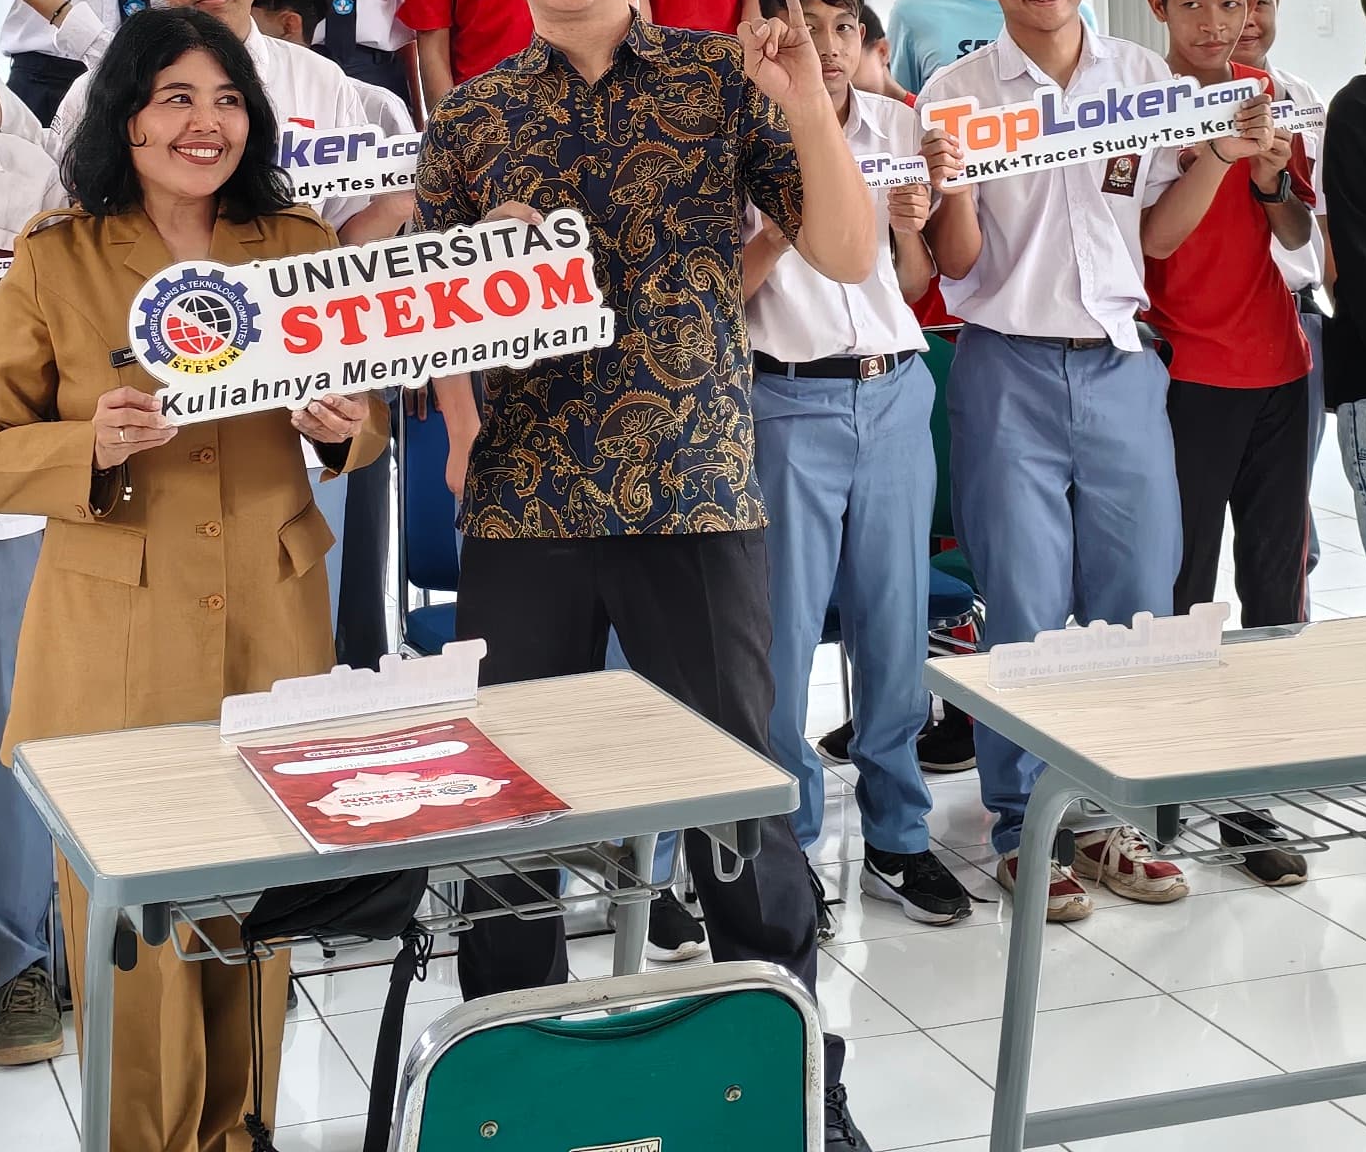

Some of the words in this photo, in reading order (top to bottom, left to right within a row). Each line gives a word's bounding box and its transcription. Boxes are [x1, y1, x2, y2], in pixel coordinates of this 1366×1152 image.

[956, 39, 996, 59] SE
[929, 84, 1254, 153] TopLoker.com
[1201, 119, 1236, 135] Ker
[280, 130, 420, 169] ker.co
[381, 171, 417, 187] Ker
[883, 178, 902, 186] Job
[268, 217, 581, 298] UNIVERSITAS
[156, 286, 179, 307] SAINS
[188, 280, 236, 301] TEKNOLOGI
[281, 257, 594, 354] STEKOM
[149, 307, 171, 359] UNIVERSITAS
[233, 299, 248, 346] KOMPUTER
[161, 370, 331, 417] Kuliahnya
[342, 324, 588, 386] Menyenangkan
[172, 350, 240, 374] STEKOM
